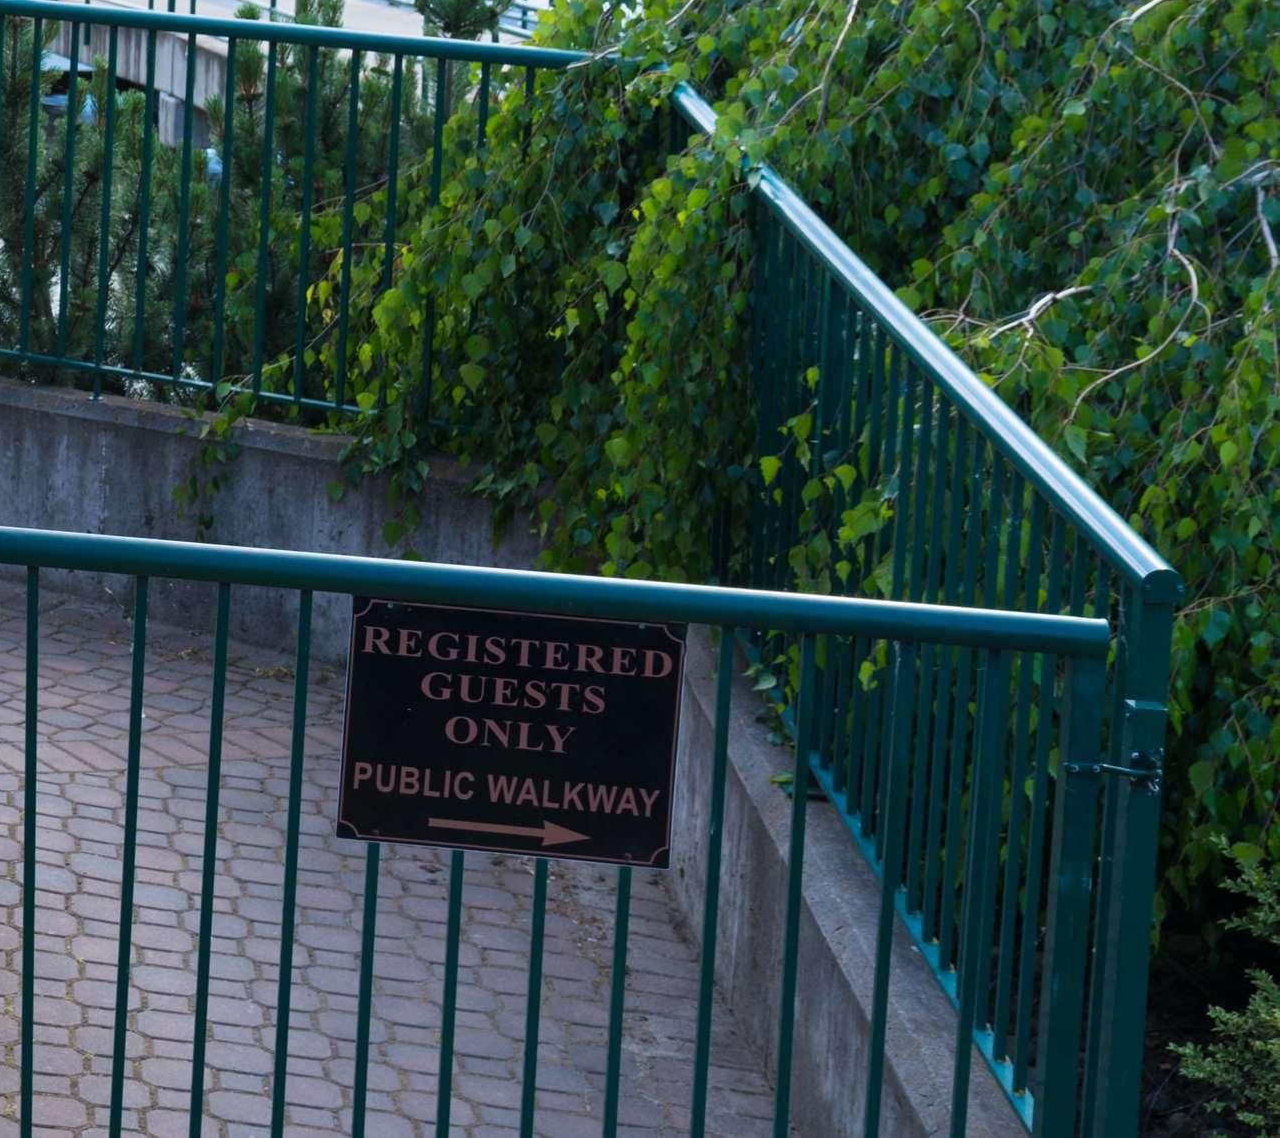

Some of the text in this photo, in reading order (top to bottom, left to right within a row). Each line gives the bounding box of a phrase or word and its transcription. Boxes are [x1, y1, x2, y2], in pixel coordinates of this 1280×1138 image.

[360, 624, 674, 679] REGISTERED
[420, 671, 607, 715] GUESTS
[444, 715, 577, 754] ONLY
[352, 761, 661, 819] PUBLIC WALKWAY
